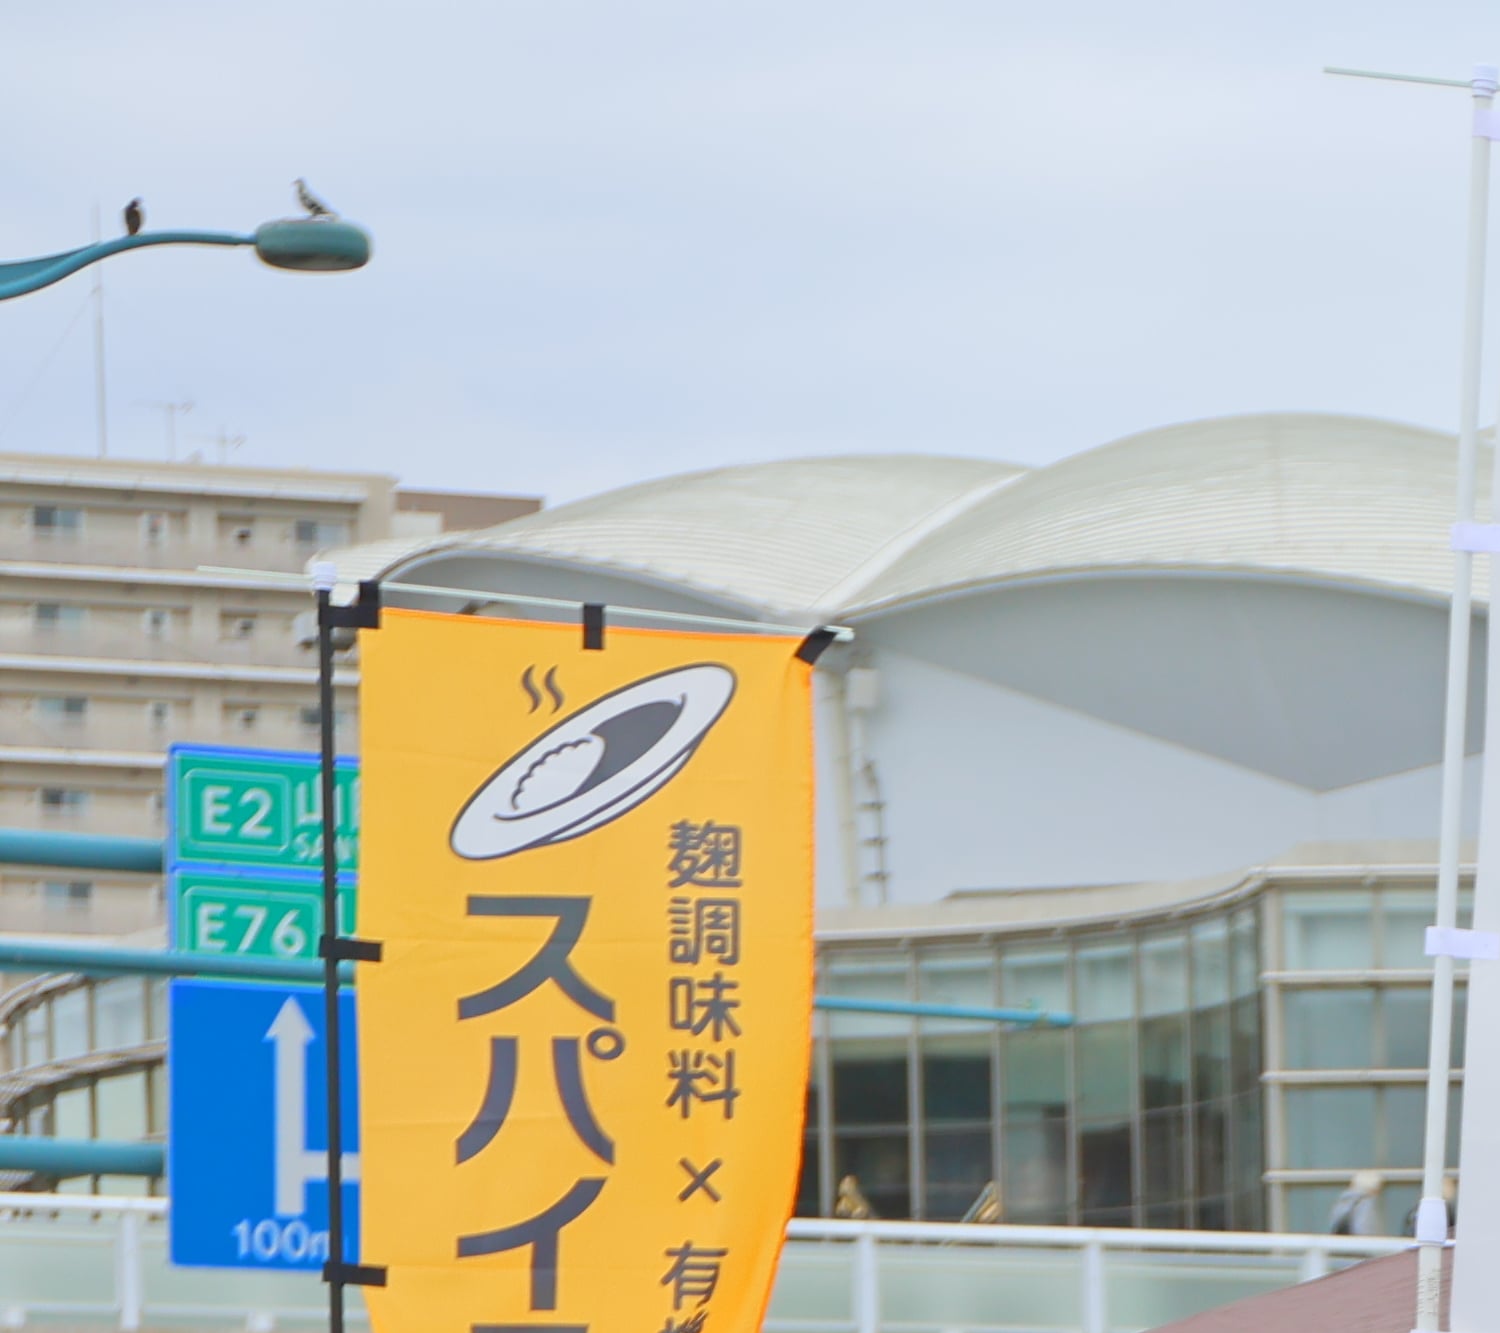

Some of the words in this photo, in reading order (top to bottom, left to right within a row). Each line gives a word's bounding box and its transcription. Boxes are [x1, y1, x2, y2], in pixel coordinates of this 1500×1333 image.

[200, 785, 275, 839] E2
[196, 901, 307, 959] E76
[665, 818, 745, 1122] 麹調味料
